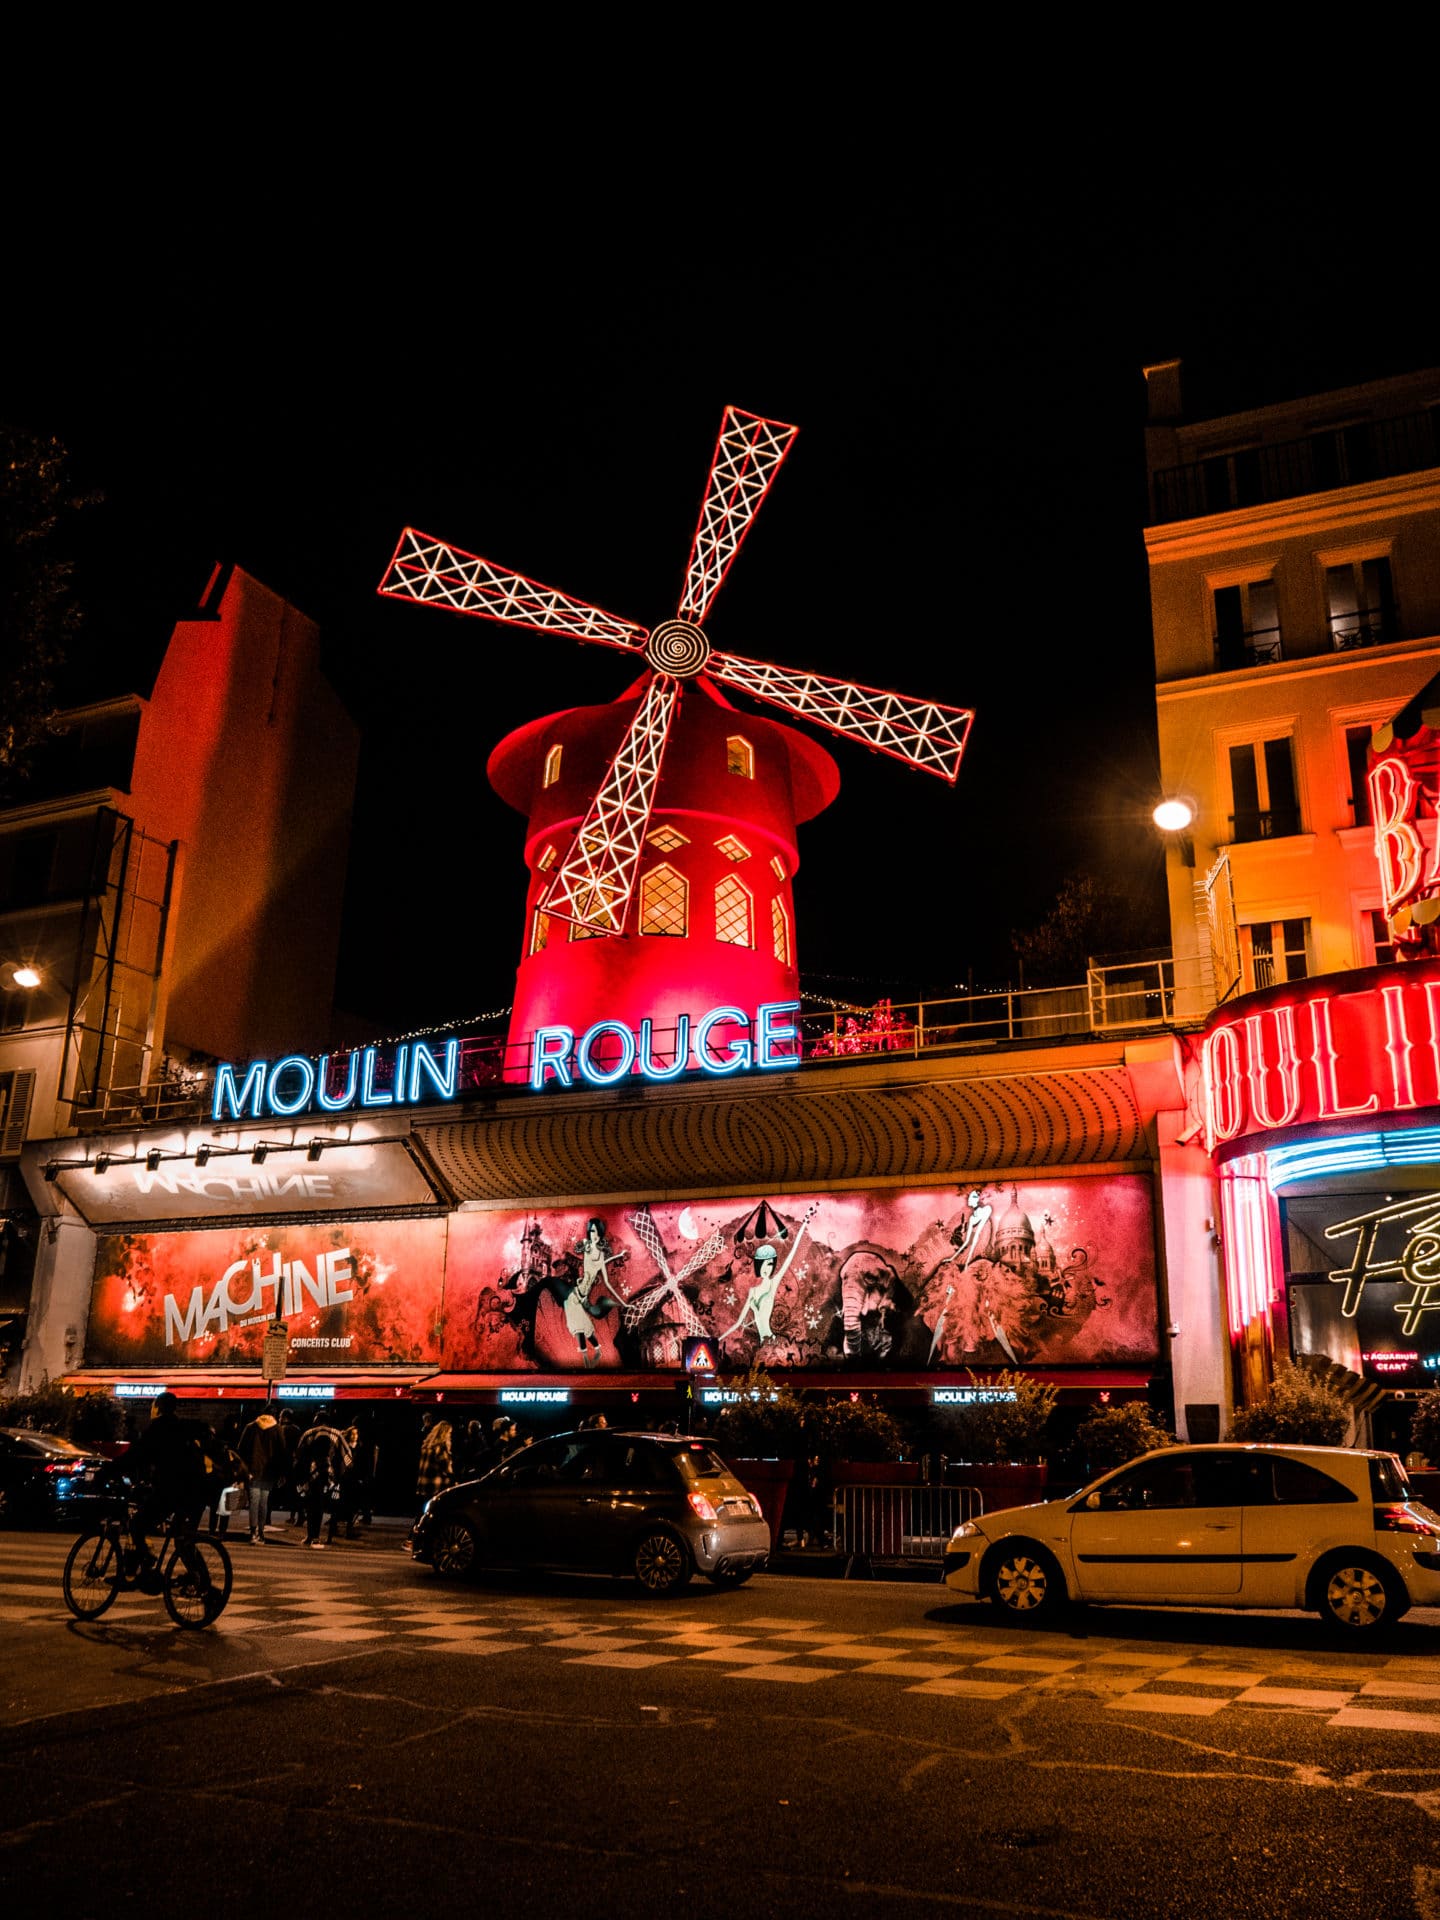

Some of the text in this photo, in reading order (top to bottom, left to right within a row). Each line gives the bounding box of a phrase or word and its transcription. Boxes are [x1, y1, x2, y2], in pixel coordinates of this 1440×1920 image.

[212, 1001, 800, 1119] MOULIN ROUGE
[163, 1247, 354, 1347] MACHINE
[291, 1337, 351, 1348] CONCERTS CLUB
[501, 1391, 569, 1402] MOULIN ROUGE
[934, 1391, 977, 1403] MOULIN
